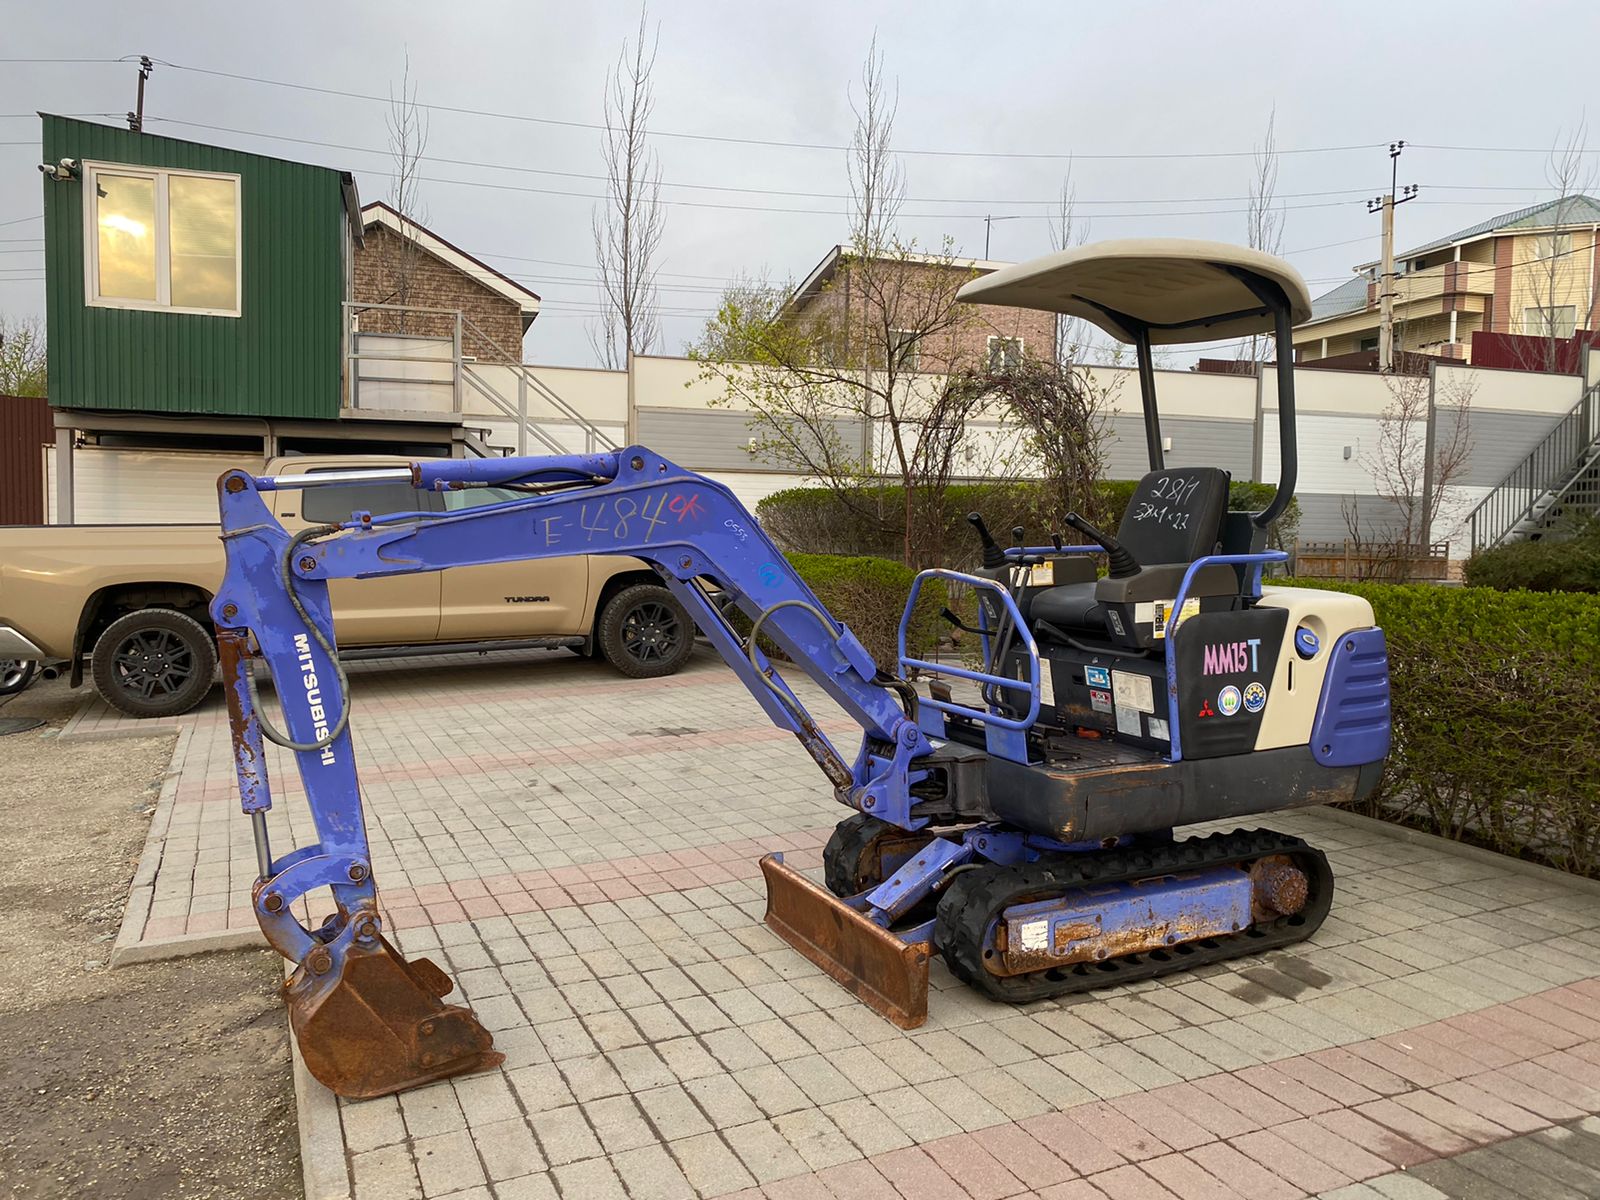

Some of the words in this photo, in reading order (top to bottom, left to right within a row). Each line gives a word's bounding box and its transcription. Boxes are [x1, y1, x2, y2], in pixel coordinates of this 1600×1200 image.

[541, 492, 668, 547] E-484
[668, 494, 705, 523] OK
[1203, 638, 1261, 675] MM15T
[293, 633, 336, 766] MITSUBISHI
